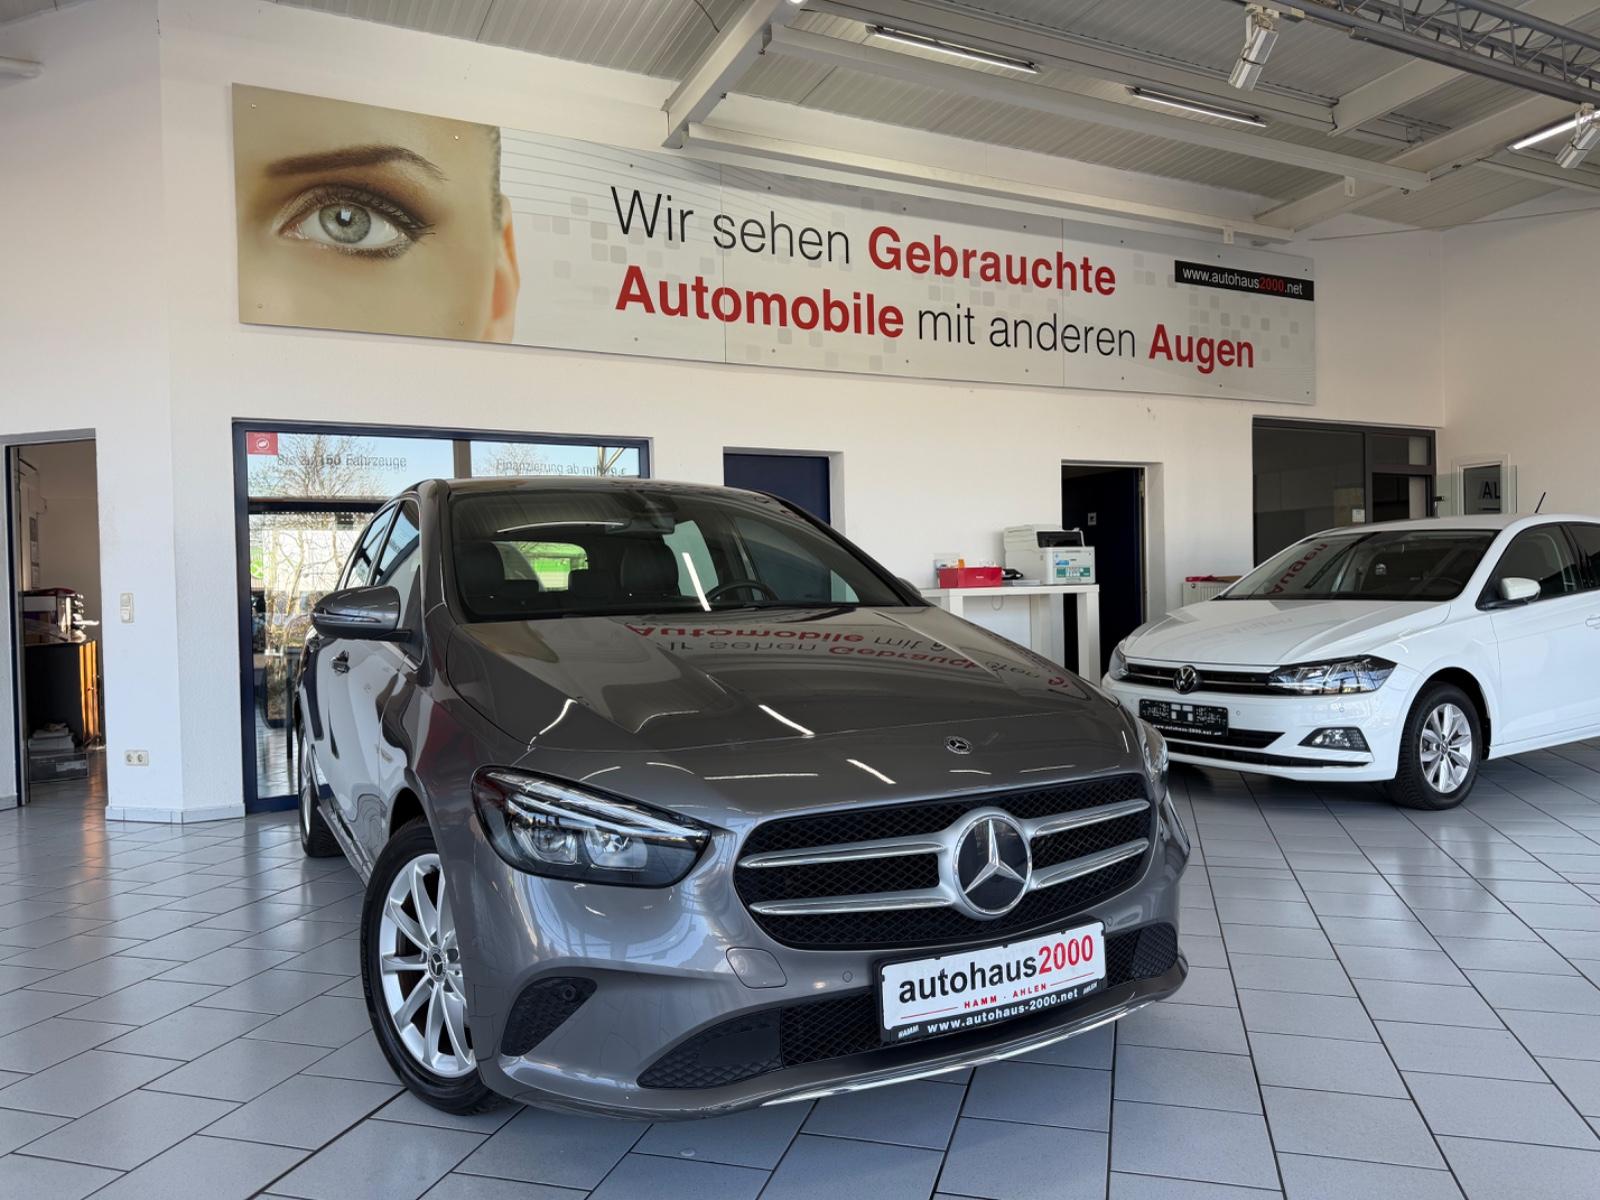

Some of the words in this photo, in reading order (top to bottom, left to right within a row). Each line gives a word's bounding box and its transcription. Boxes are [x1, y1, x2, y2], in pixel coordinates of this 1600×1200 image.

[611, 186, 694, 242] Wir
[713, 211, 850, 264] sehen
[868, 226, 1116, 296] Gebrauchte
[1182, 267, 1303, 296] www.autohaus2000.net
[615, 265, 904, 338] Automobile
[918, 303, 975, 345] mit
[989, 313, 1135, 358] anderen
[1149, 323, 1254, 374] Augen
[346, 454, 407, 471] Fahrzeuge
[899, 934, 1094, 1004] autohaus2000
[927, 989, 1078, 1034] www.autohaus-2000.net
[964, 995, 998, 1009] HAMM
[1012, 983, 1048, 999] AHLEN
